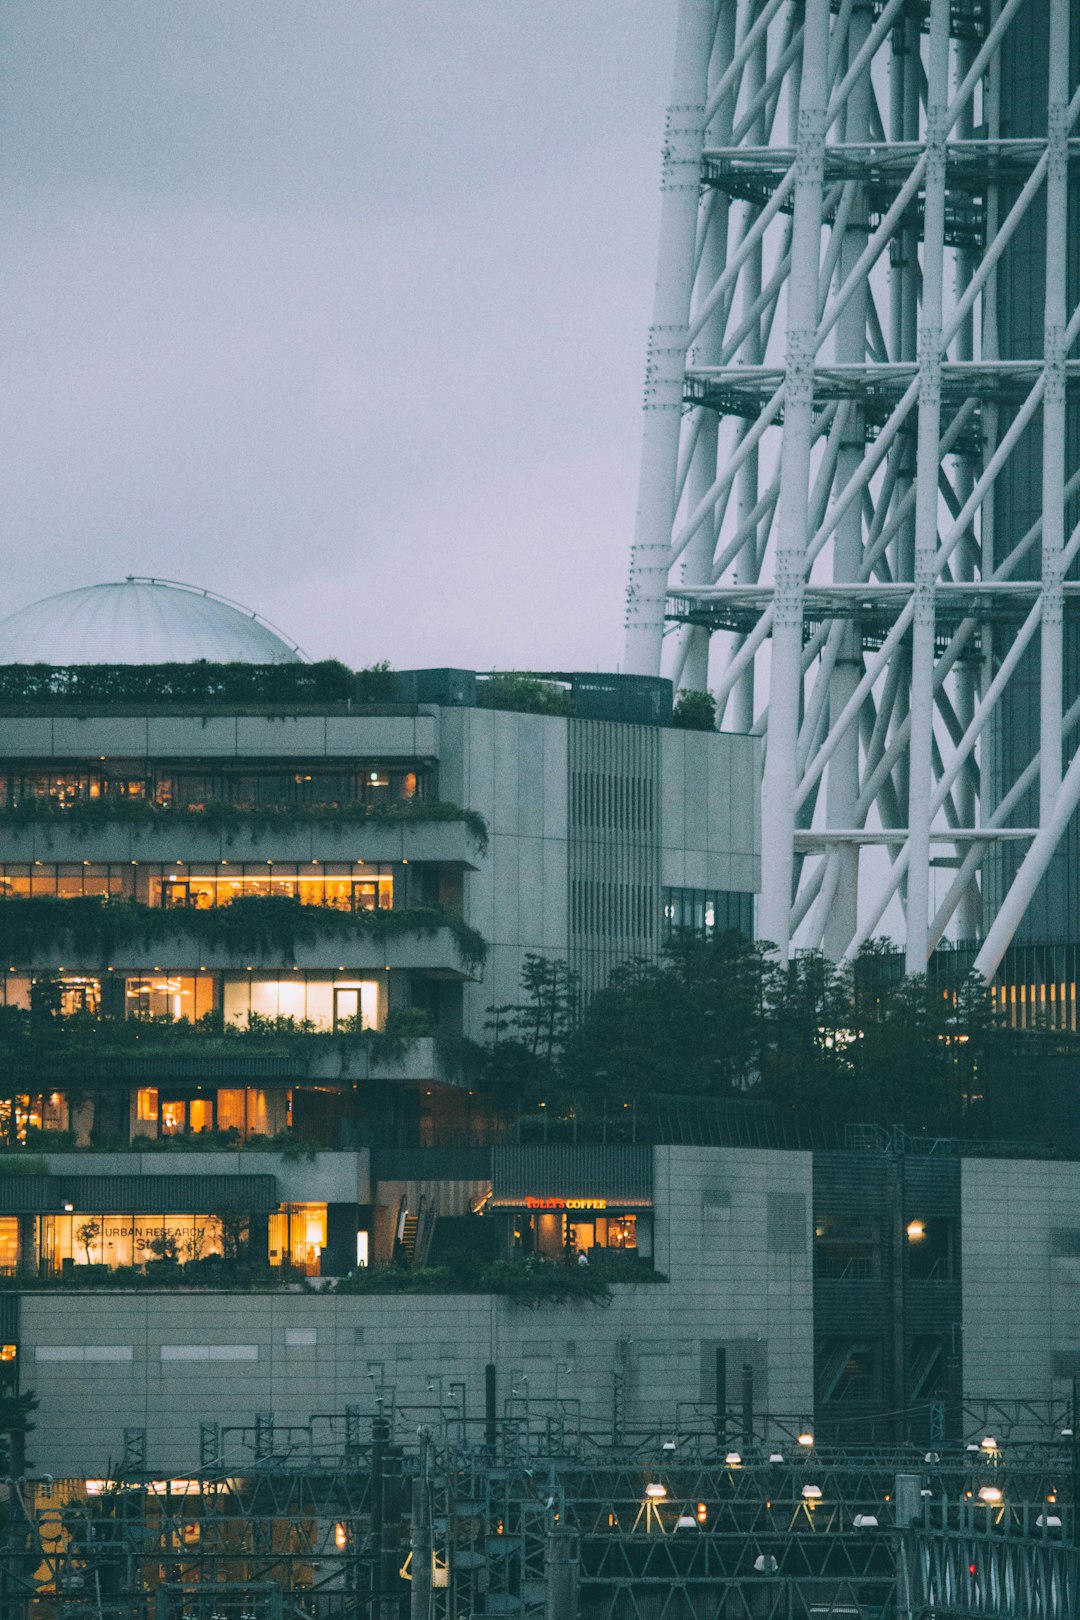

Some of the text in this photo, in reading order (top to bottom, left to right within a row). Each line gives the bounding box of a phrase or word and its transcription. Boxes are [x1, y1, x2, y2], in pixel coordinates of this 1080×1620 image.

[566, 1199, 607, 1209] COFFEE
[105, 1228, 205, 1237] URBAN RESEARCH
